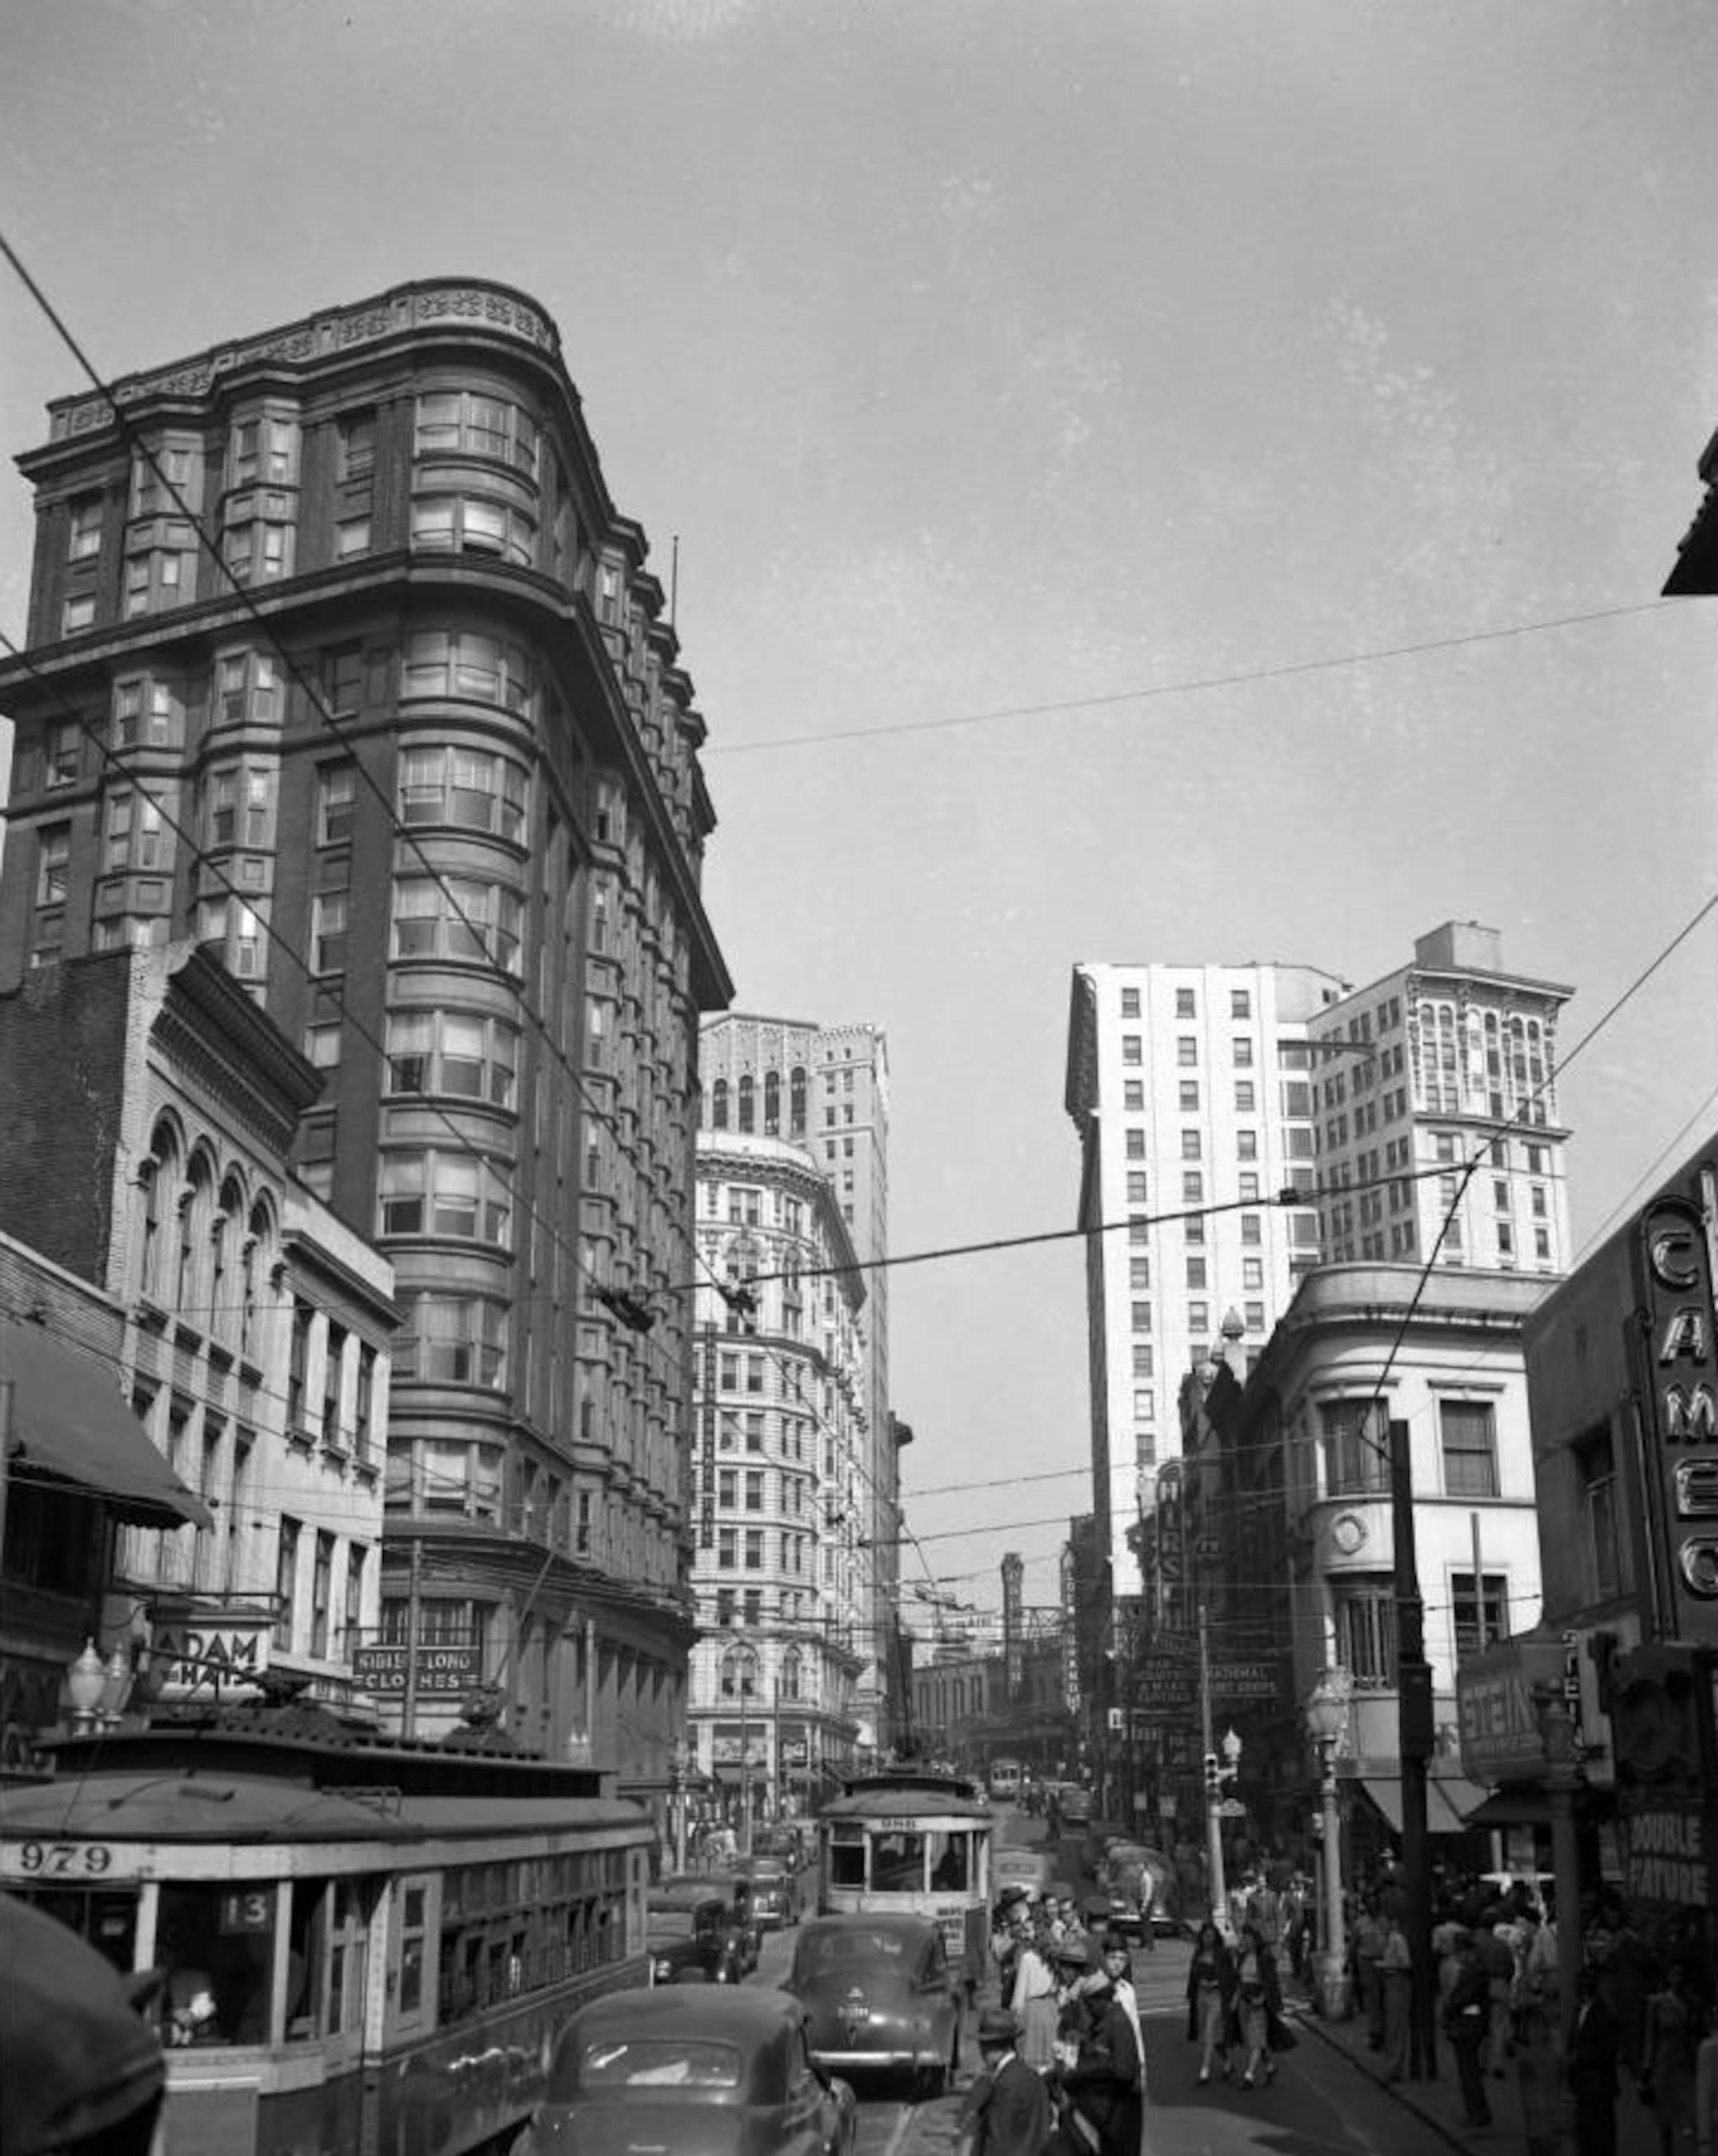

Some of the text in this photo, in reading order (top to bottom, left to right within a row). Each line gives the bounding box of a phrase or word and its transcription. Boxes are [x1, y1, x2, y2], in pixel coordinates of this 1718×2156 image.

[157, 1631, 258, 1665] ADAM
[366, 1673, 459, 1688] CLOHES
[1630, 1812, 1702, 1858] DOUBLE
[21, 1841, 111, 1873] 979
[228, 1893, 267, 1925] 13
